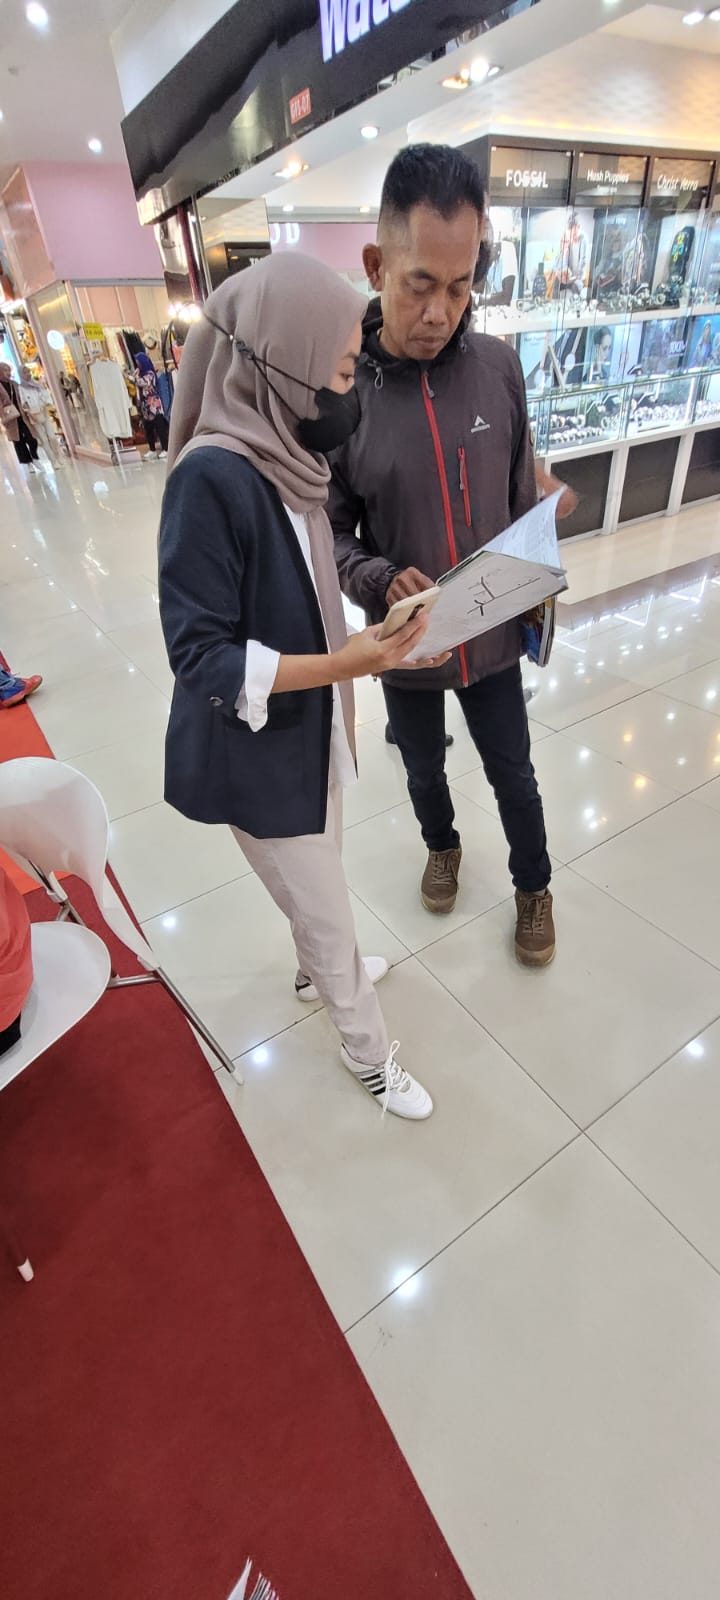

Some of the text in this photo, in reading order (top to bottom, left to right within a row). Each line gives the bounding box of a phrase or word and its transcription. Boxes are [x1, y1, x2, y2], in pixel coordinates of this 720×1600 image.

[506, 169, 549, 188] FOSSIL
[587, 169, 629, 184] Hush Puppies
